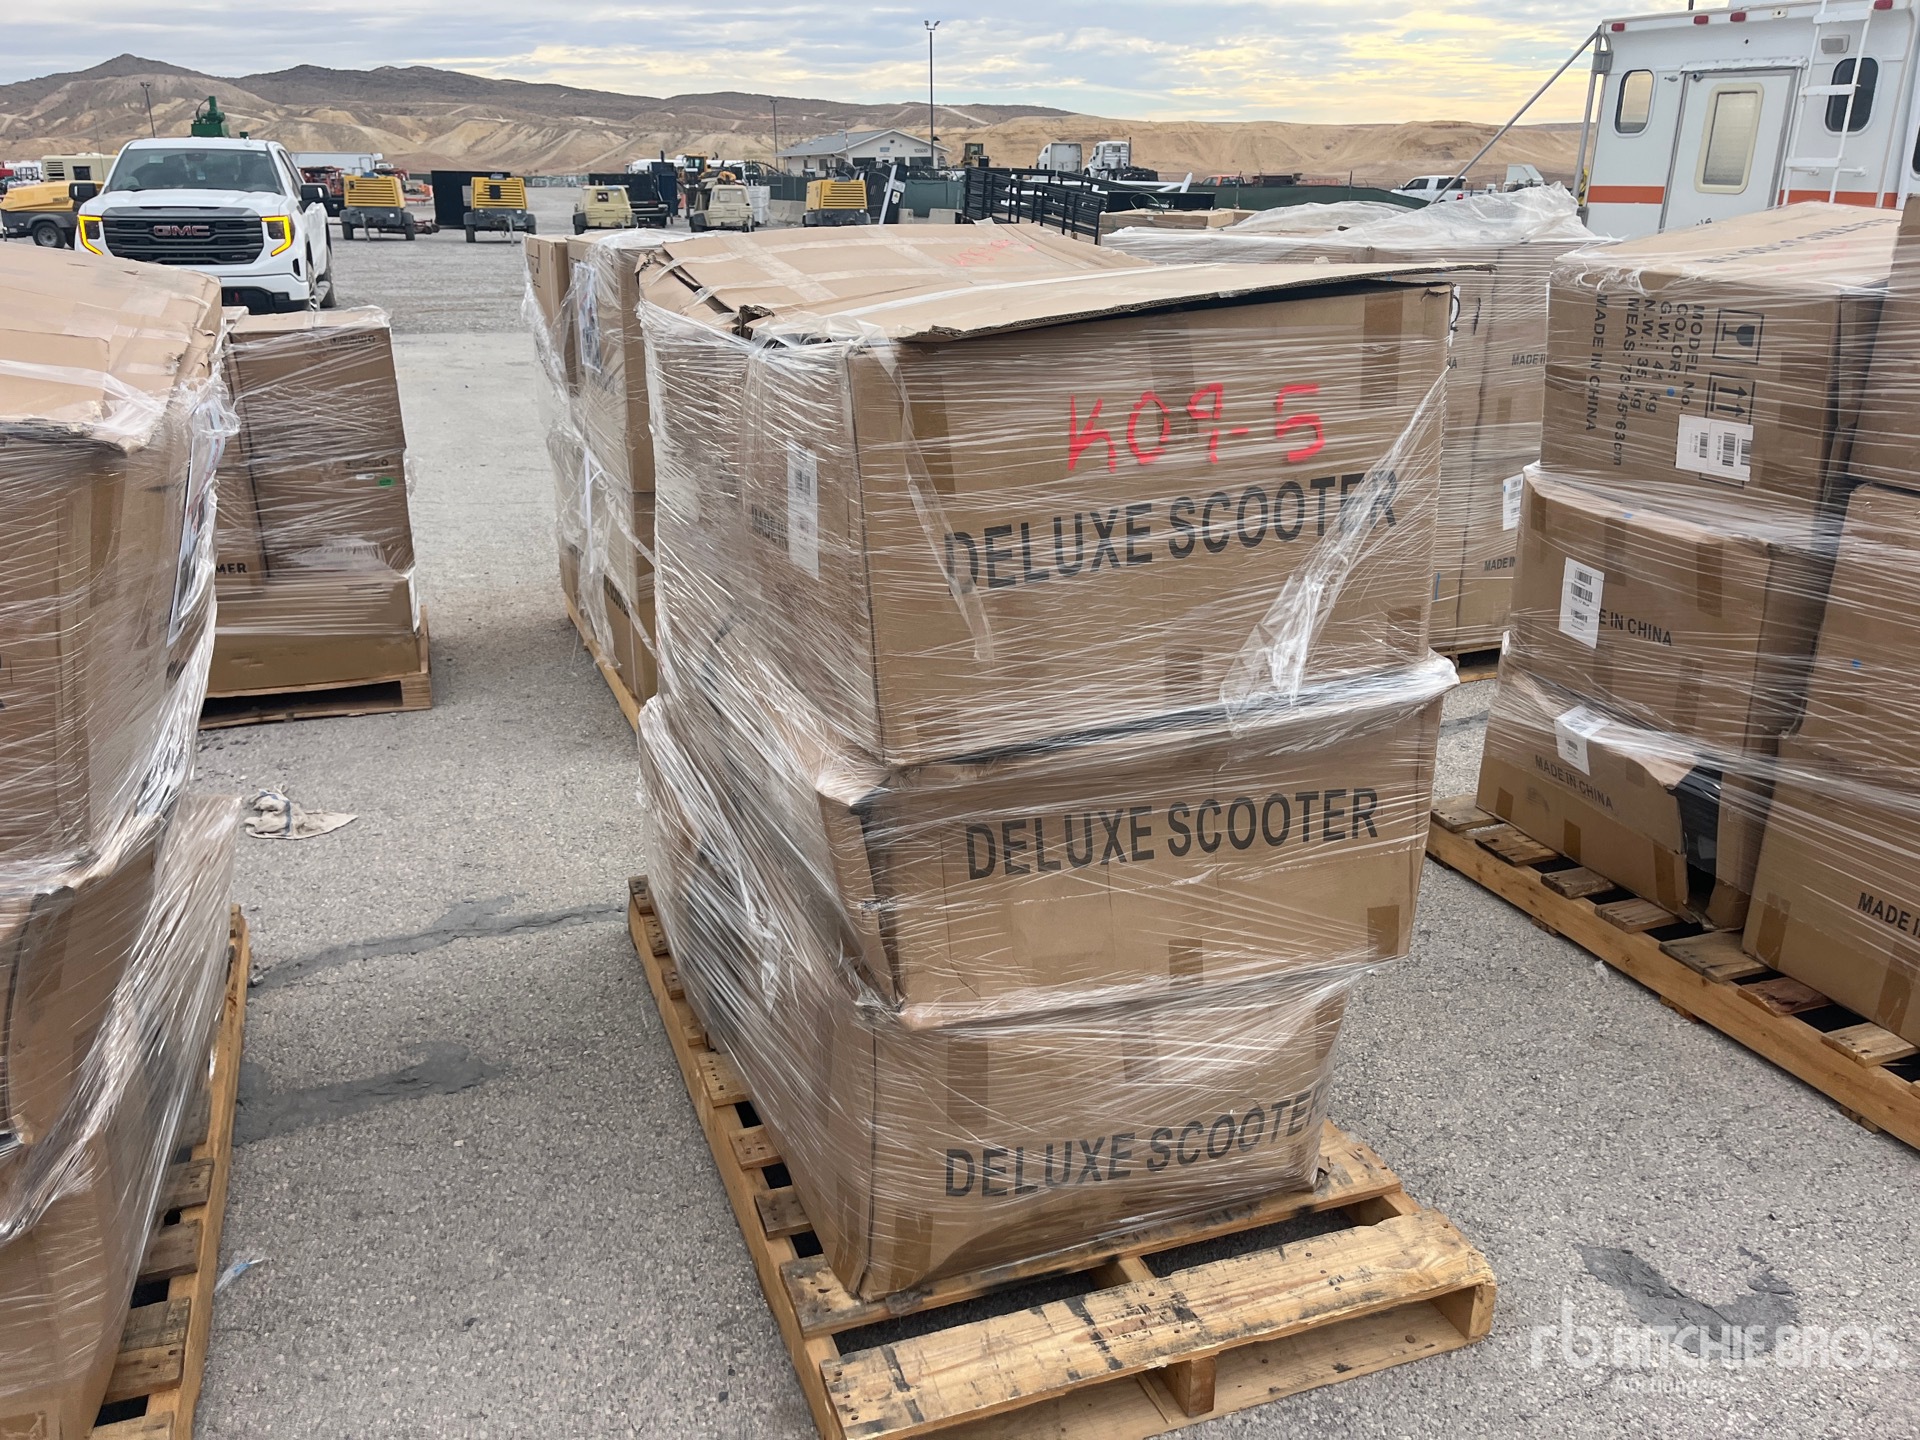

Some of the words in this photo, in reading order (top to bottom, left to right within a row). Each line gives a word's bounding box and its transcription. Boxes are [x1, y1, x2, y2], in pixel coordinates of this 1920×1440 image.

[153, 225, 210, 236] GMC
[1592, 294, 1608, 347] MADE
[1622, 298, 1641, 358] MEAS:
[1667, 304, 1688, 379] COLOR:
[1684, 305, 1705, 375] MODEL
[1512, 354, 1539, 366] MADE
[1590, 353, 1602, 370] IN
[1635, 357, 1649, 379] 35
[1585, 376, 1600, 431] CHINA
[1630, 389, 1645, 409] kg
[1645, 392, 1661, 413] kg
[944, 503, 1153, 596] DELUXE
[1169, 470, 1398, 559] SCOOTER
[1484, 558, 1508, 571] MADE
[1611, 612, 1624, 631] IN
[1627, 618, 1672, 647] CHINA
[1535, 755, 1564, 781] MADE
[1564, 772, 1577, 789] IN
[1579, 780, 1613, 811] CHINA
[966, 805, 1155, 880] DELUXE
[1168, 788, 1378, 856] SCOOTER
[1858, 892, 1911, 931] MADE
[1912, 918, 1920, 939] I
[945, 1132, 1135, 1197] DELUXE
